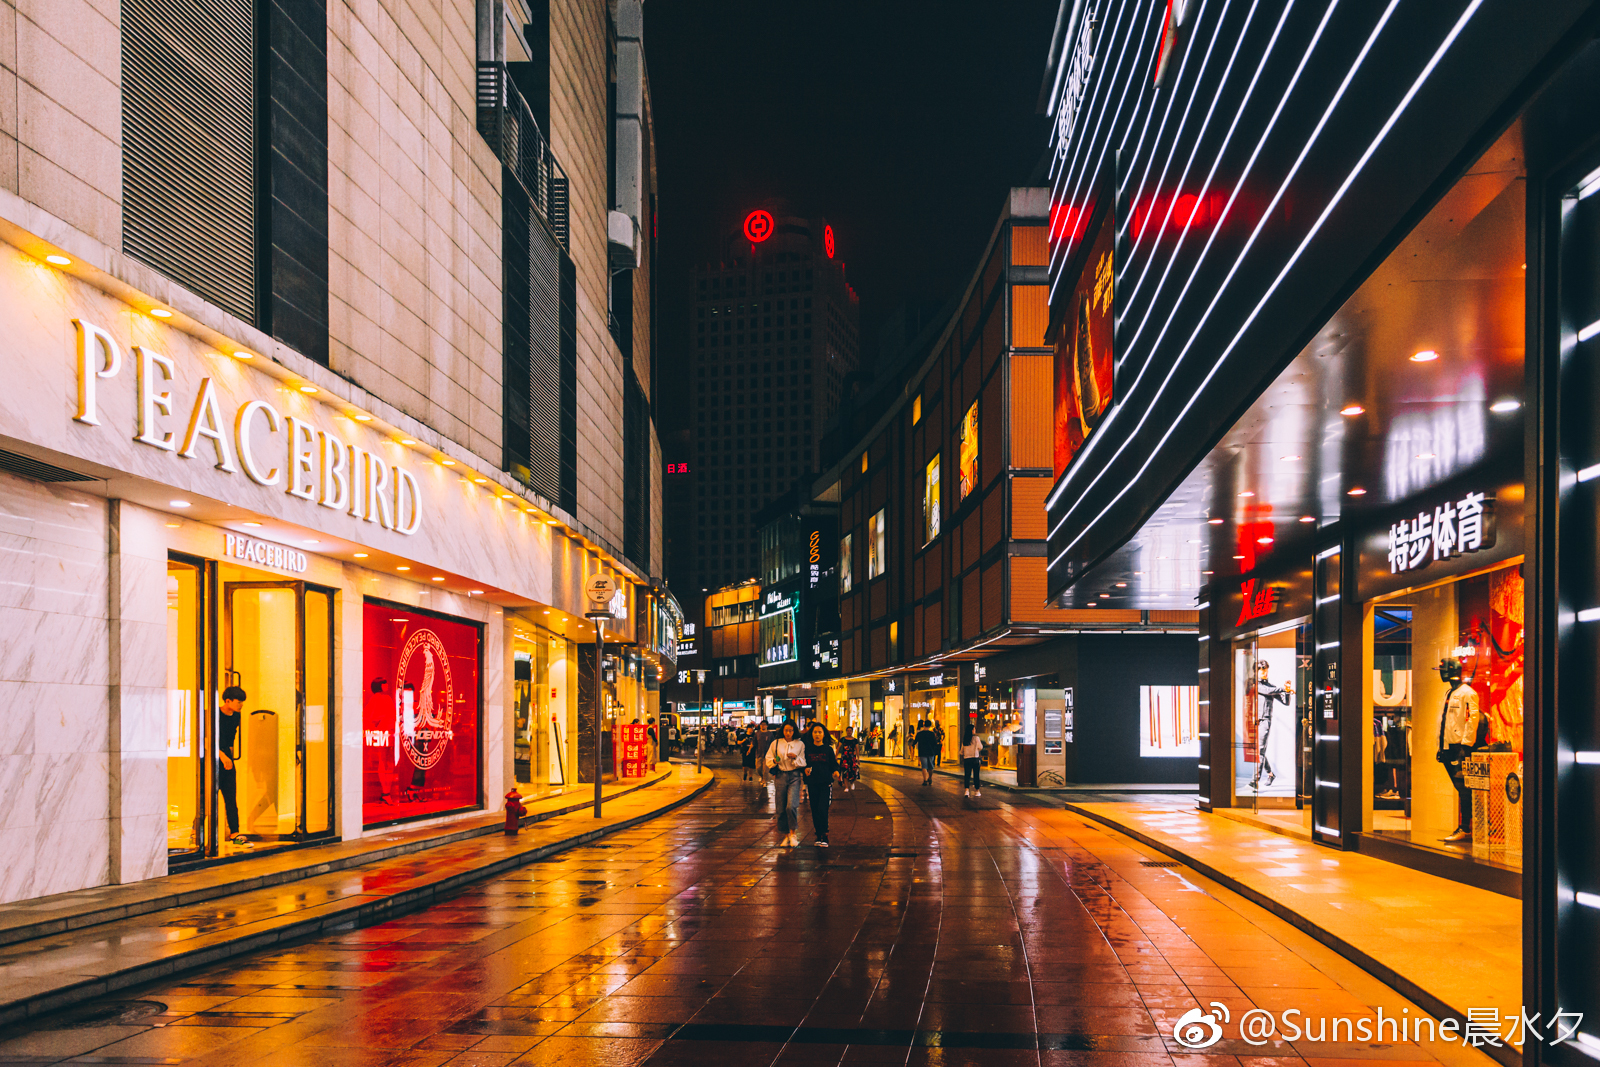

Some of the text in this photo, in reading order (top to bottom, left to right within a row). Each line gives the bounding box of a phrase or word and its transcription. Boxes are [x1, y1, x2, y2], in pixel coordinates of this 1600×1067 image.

[72, 318, 423, 536] PEACEBIRD
[224, 533, 308, 573] PEACEBIRD
[1387, 491, 1486, 574] 特步体育
[410, 749, 441, 766] PEACEBIRD
